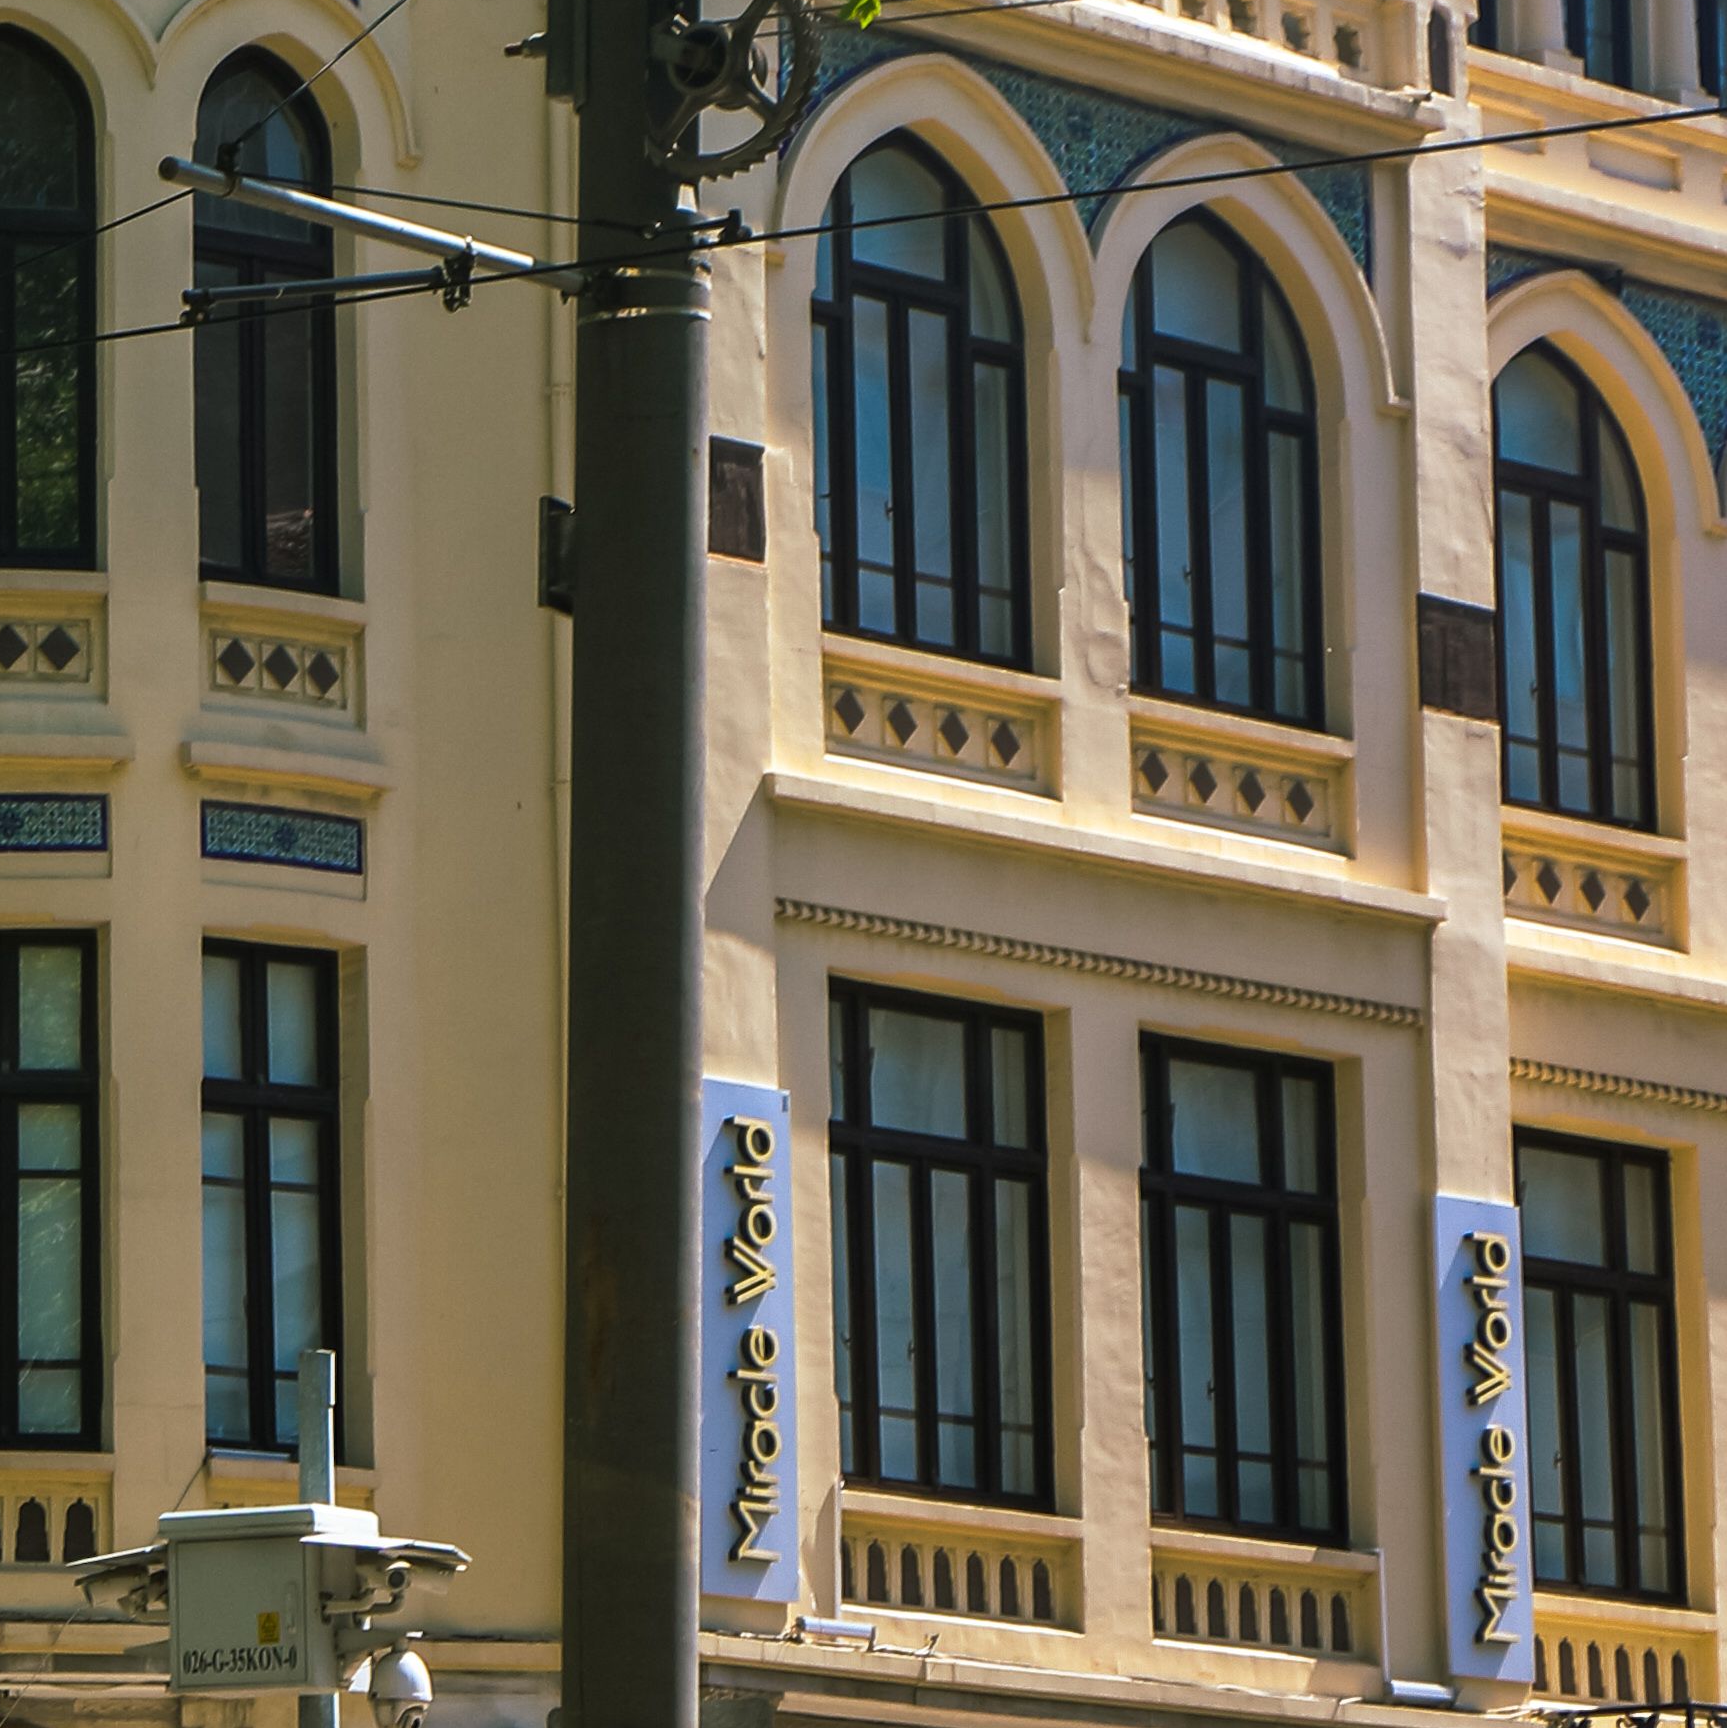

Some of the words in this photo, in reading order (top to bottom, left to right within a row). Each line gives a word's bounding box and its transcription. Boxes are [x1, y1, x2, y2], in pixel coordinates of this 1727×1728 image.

[724, 1114, 778, 1306] World
[1462, 1231, 1513, 1408] World
[727, 1324, 782, 1564] Miracle
[1469, 1424, 1520, 1644] Miracle
